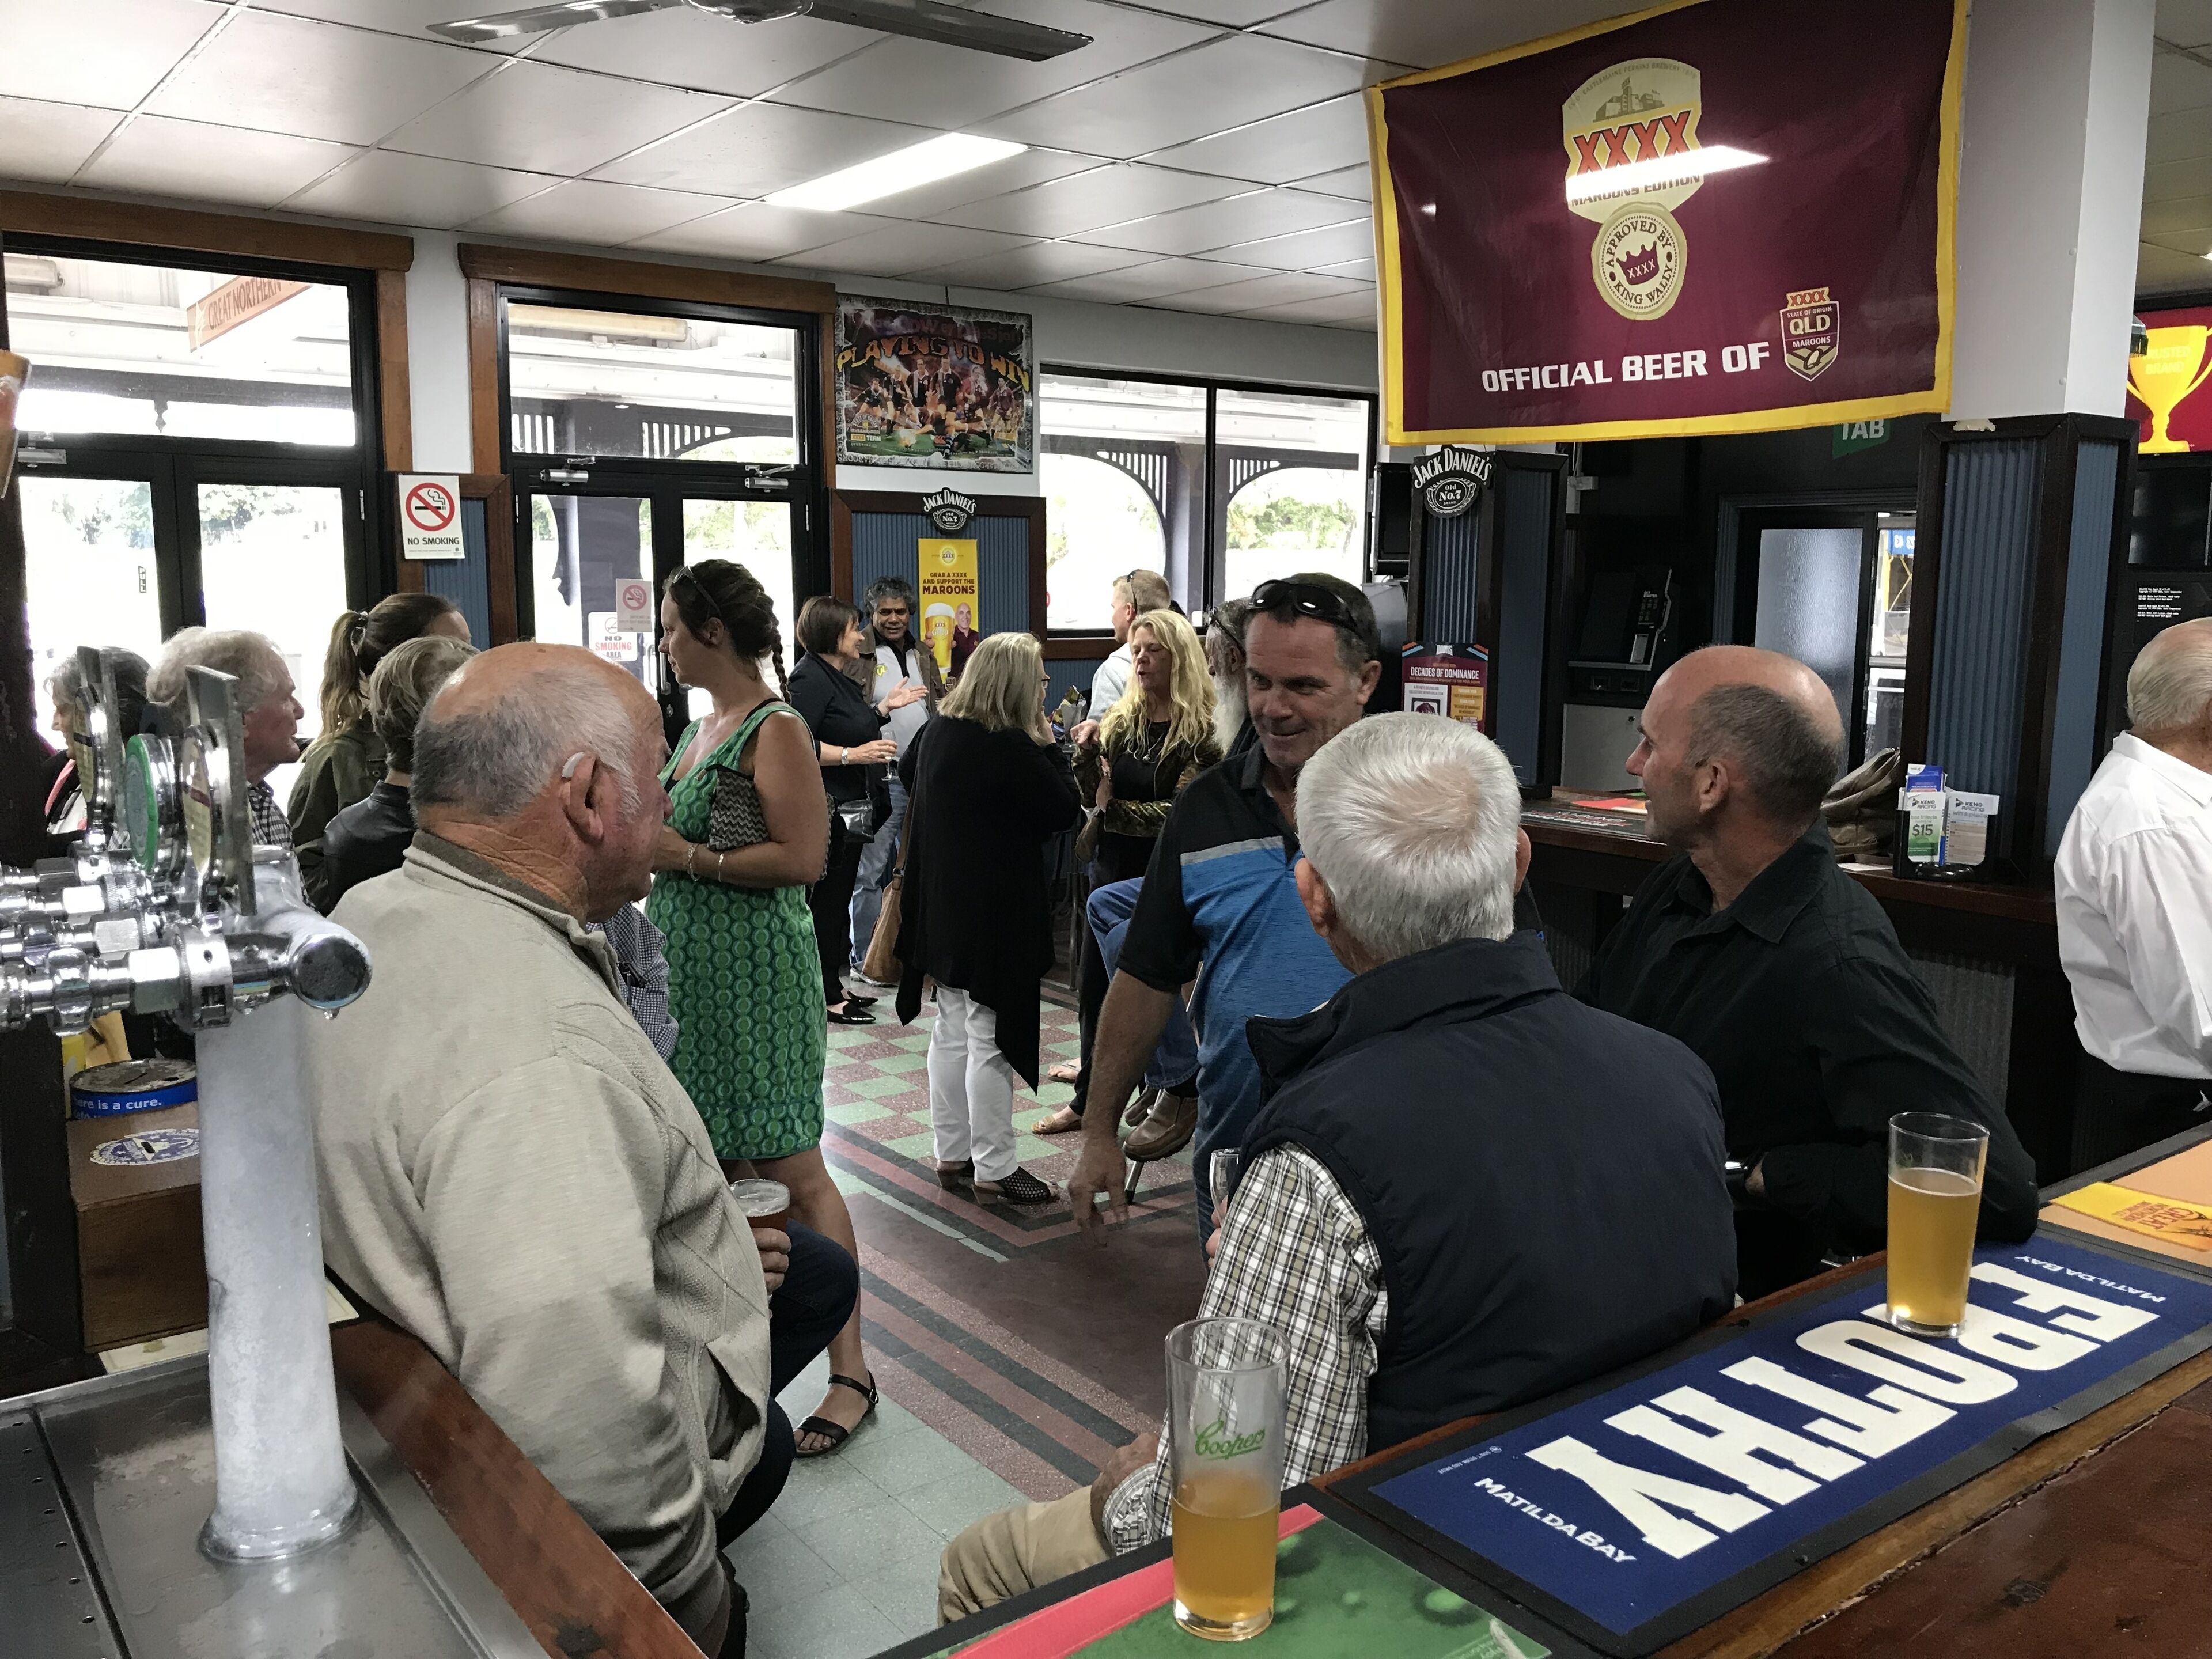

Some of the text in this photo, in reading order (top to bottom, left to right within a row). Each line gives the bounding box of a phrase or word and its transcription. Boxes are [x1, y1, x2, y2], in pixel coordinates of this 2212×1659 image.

[1573, 110, 1691, 176] XXXX
[1606, 220, 1672, 268] APPROVED BY
[1627, 258, 1656, 278] XXXX
[1613, 263, 1673, 304] KING WALLY
[1790, 290, 1825, 306] XXXX
[208, 290, 231, 330] GREAT
[1812, 306, 1832, 314] ORIGIN
[1789, 314, 1831, 335] QLD
[1793, 336, 1831, 347] MAROONS
[1482, 342, 1770, 392] OFFICIAL BEER OF
[1413, 448, 1492, 488] JACK DANIEL'S
[923, 490, 976, 514] JACK DANIEL'S
[922, 585, 975, 594] MAROONS
[595, 642, 632, 650] SMOKING
[1411, 666, 1479, 679] DECADES OF DOMINANCE
[1912, 824, 1933, 836] $15
[98, 1100, 108, 1110] is
[113, 1102, 120, 1110] a
[126, 1099, 162, 1109] cure.
[2066, 1268, 2166, 1303] MATILDA
[1524, 1262, 2160, 1559] FROTHY
[1474, 1478, 1637, 1563] MATILDA BAY
